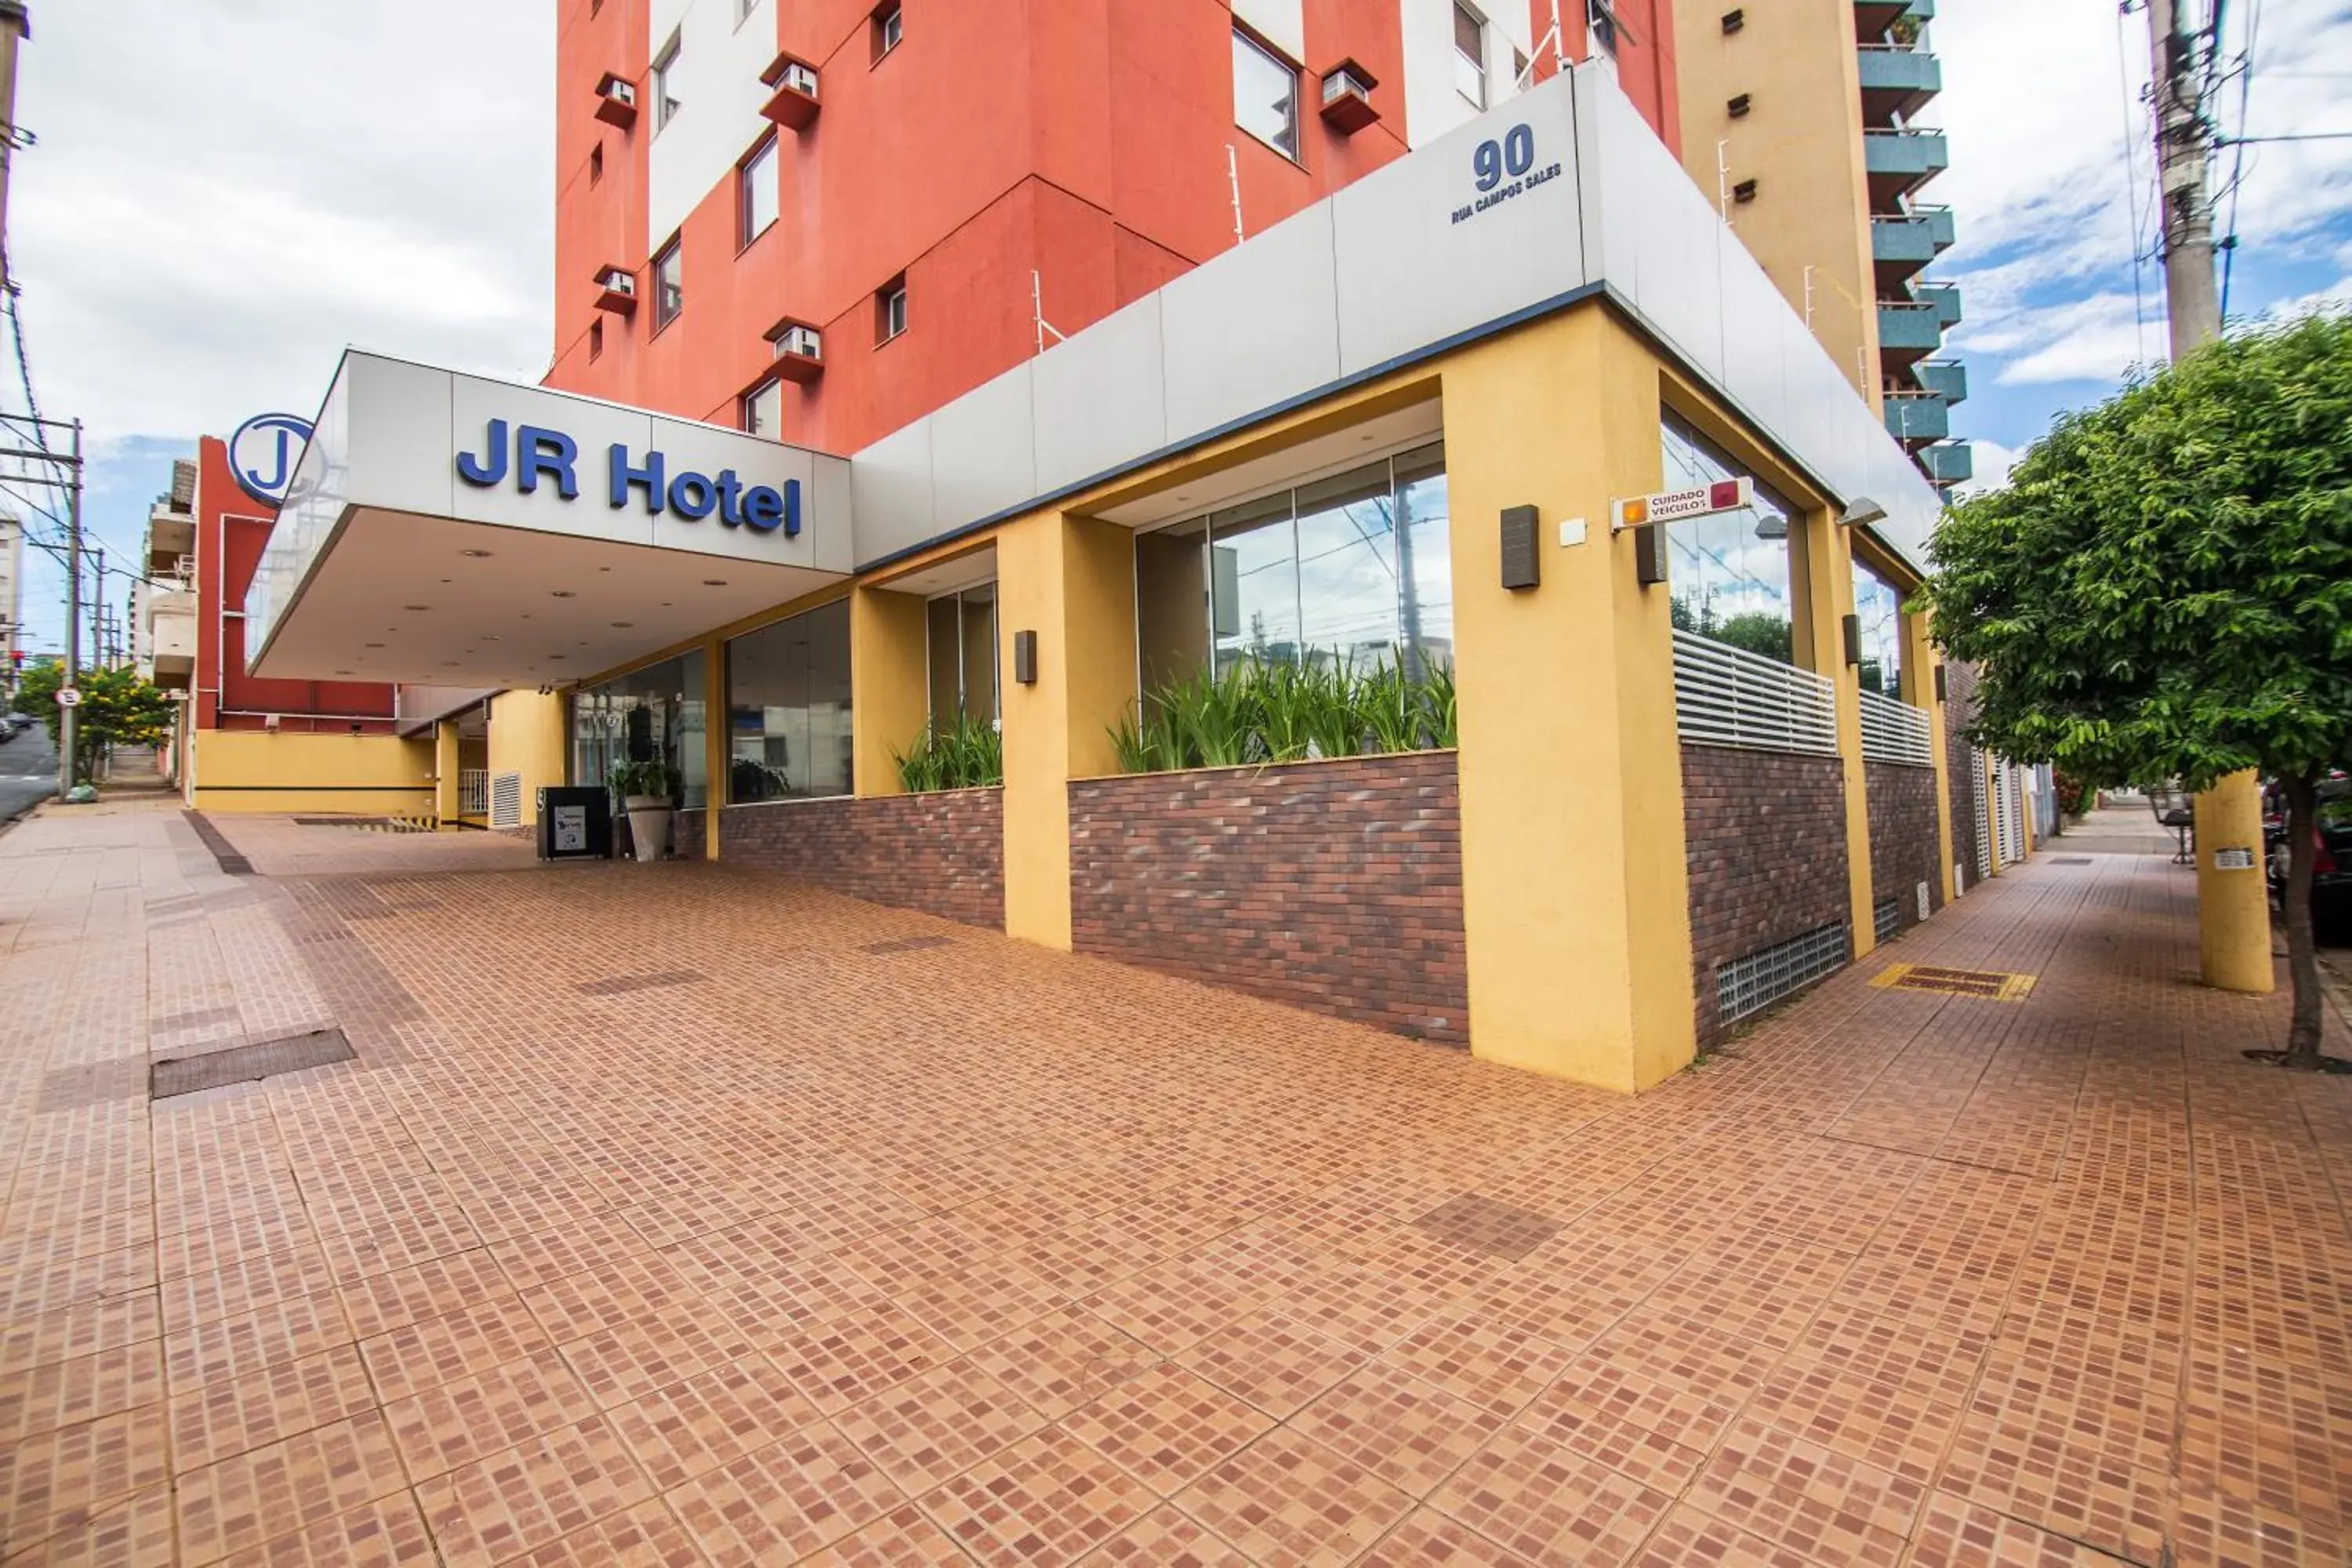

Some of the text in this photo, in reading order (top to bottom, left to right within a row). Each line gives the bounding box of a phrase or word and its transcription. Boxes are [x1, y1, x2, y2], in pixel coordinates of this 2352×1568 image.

[1473, 123, 1534, 191] 90
[1451, 163, 1561, 224] RUA CAMPOS SALES
[456, 418, 800, 537] JR Hotel
[1652, 489, 1705, 506] CUIDADO
